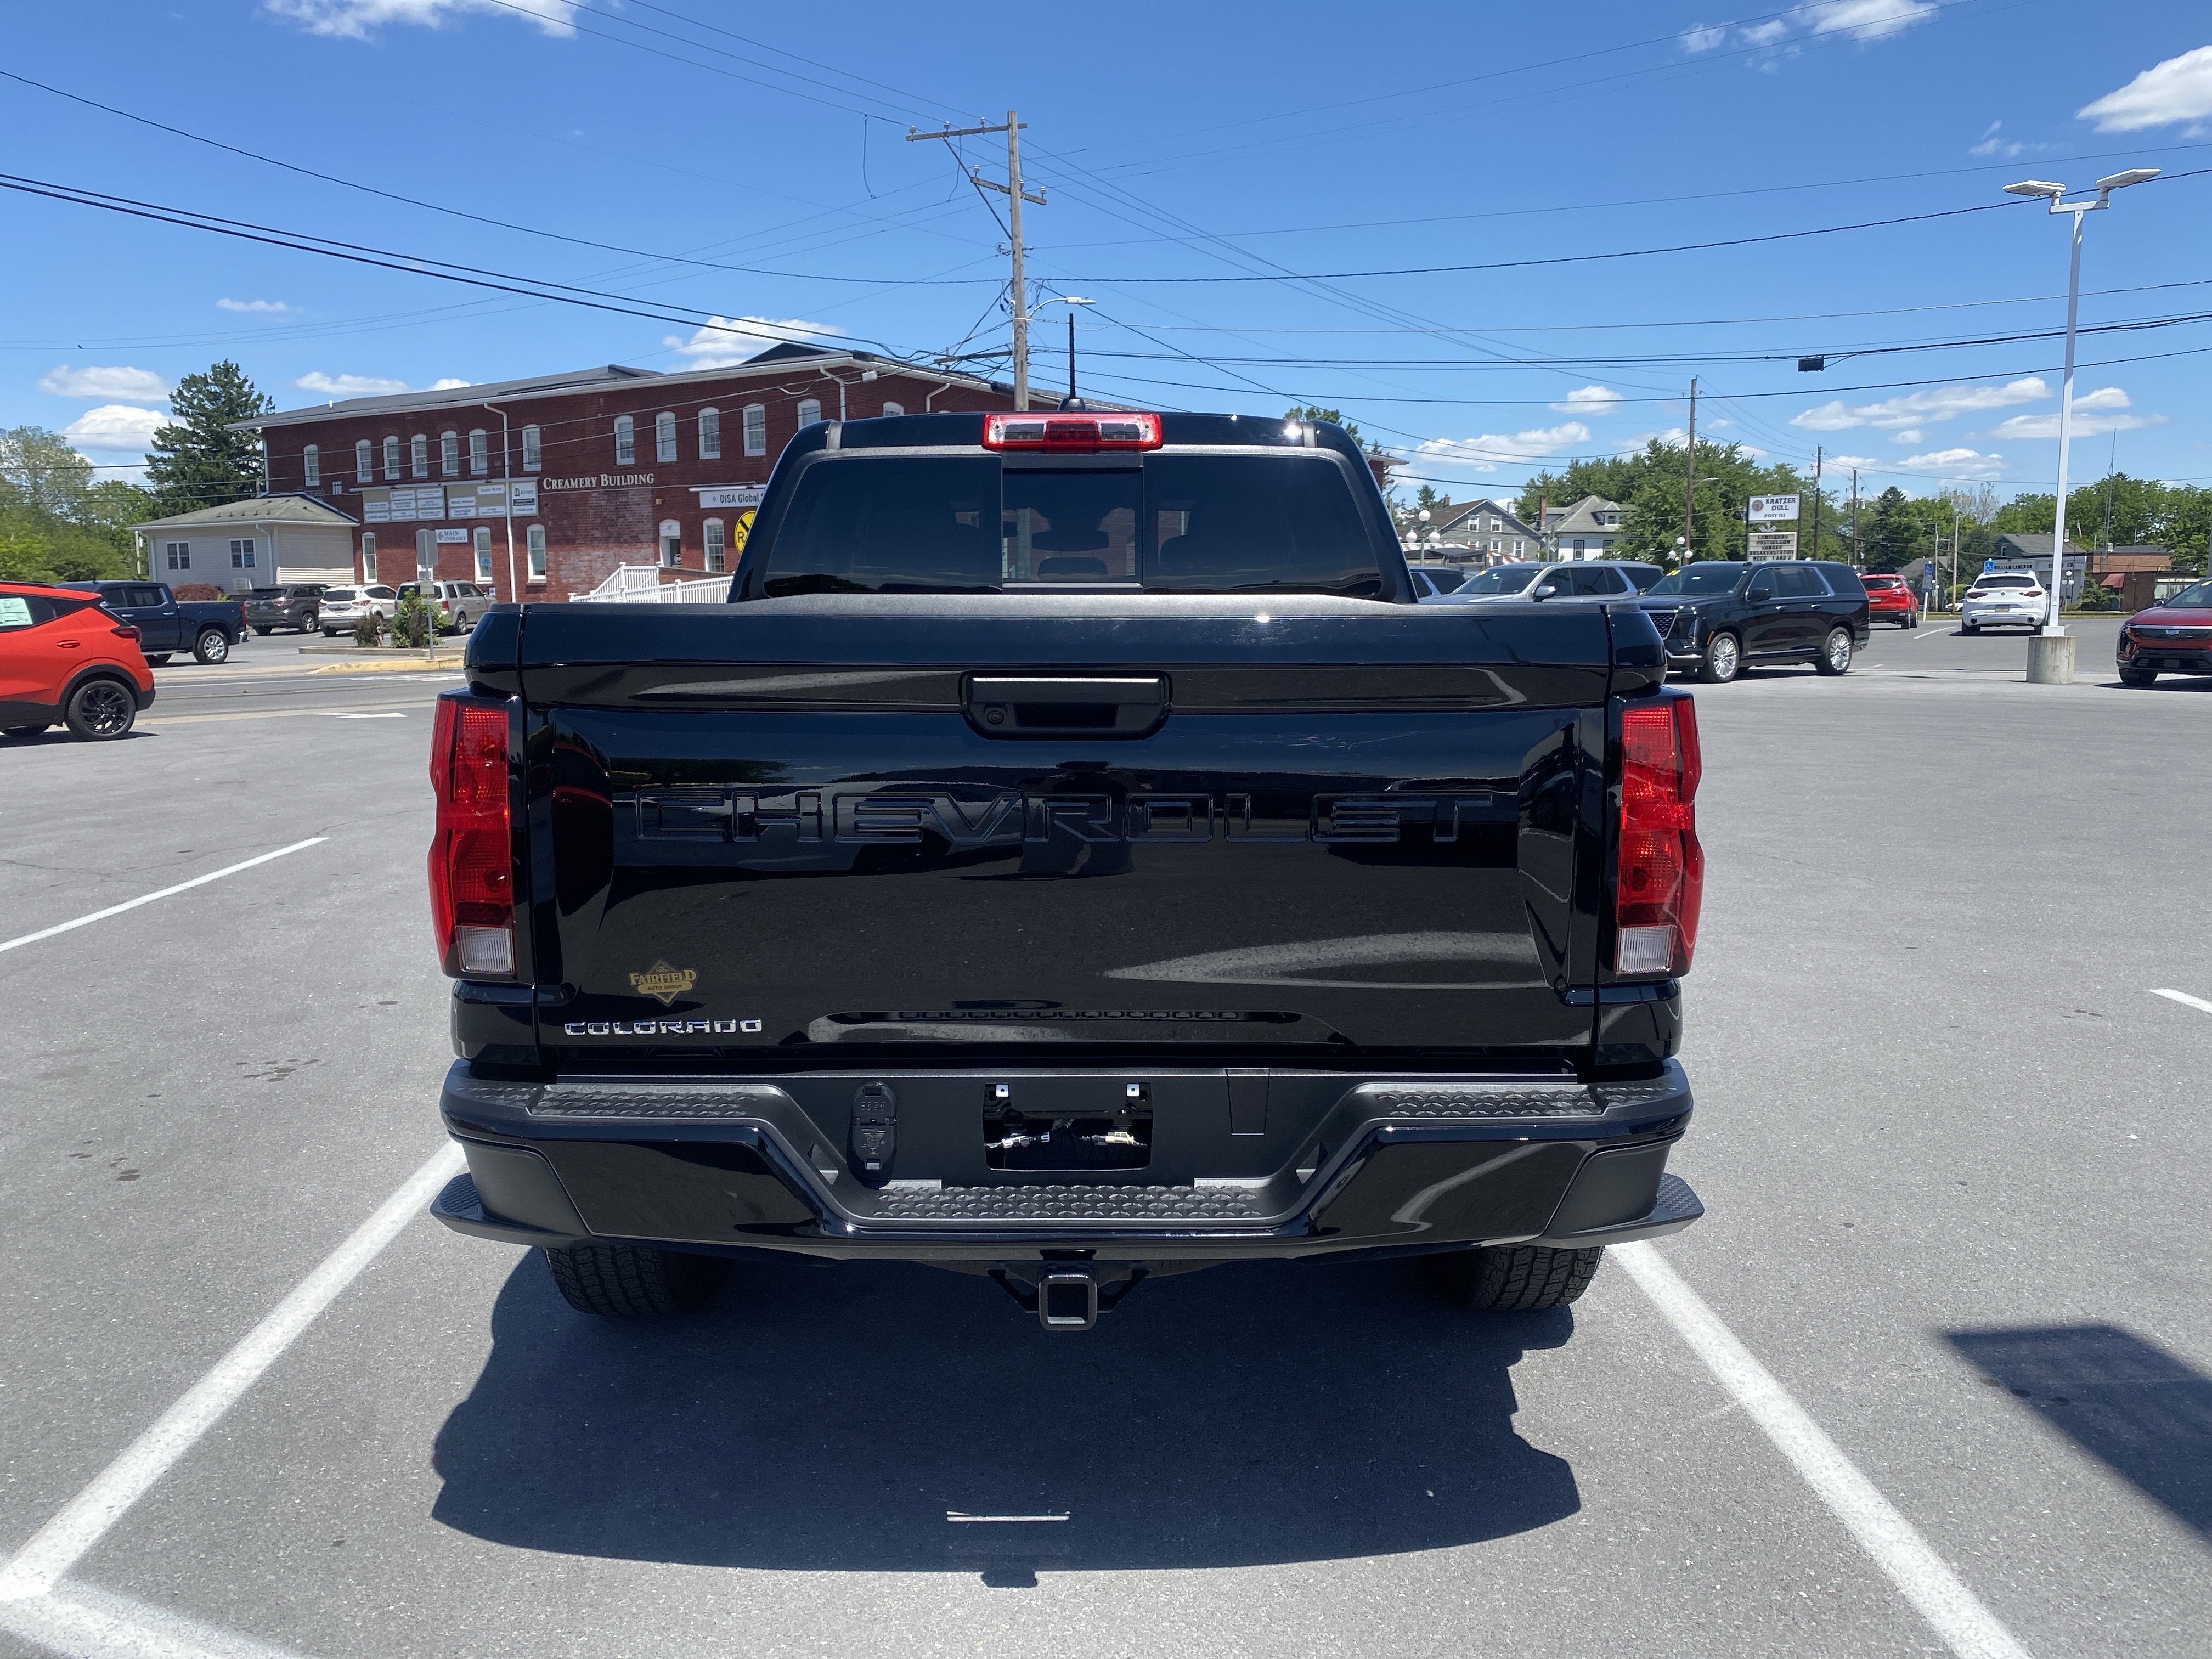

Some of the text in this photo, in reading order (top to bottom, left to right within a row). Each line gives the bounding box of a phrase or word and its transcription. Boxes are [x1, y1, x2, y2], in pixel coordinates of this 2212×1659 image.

[600, 473, 654, 487] BUILDING
[720, 495, 736, 504] DISA
[738, 493, 759, 503] Global
[737, 532, 744, 543] R
[636, 790, 1493, 844] CHEVROLET
[629, 969, 697, 985] FAIRFIELD
[565, 1019, 763, 1036] COLORADO
